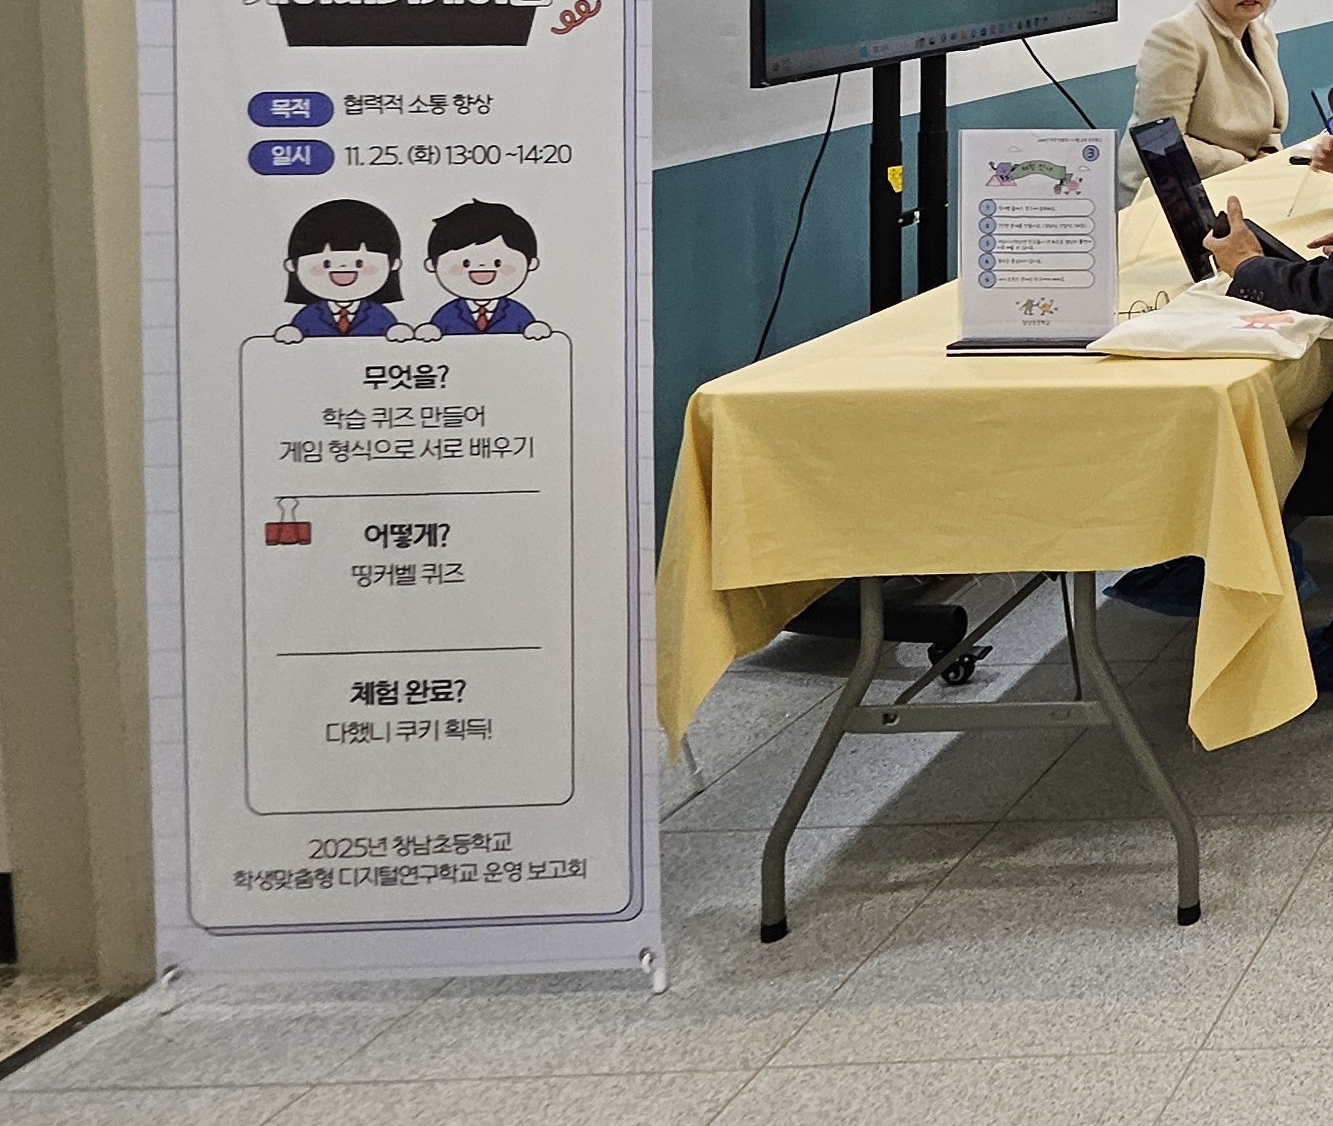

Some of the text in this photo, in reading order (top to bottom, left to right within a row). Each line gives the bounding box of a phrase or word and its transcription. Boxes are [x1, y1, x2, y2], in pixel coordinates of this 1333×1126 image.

[270, 98, 311, 118] 목적
[343, 94, 494, 115] 협력적 소통 향상
[271, 145, 312, 166] 일시
[407, 144, 442, 166] (화)
[447, 145, 501, 165] 13:00
[362, 364, 450, 390] 무엇을?
[322, 405, 486, 430] 학습 퀴즈 만들어
[278, 436, 534, 463] 게임 형식으로 서로 배우기
[364, 522, 450, 548] 어떻게?
[351, 562, 465, 588] 띵커벨 퀴즈
[350, 679, 467, 706] 체험 완료?
[326, 718, 492, 745] 다했니 쿠키 획득!
[308, 837, 388, 860] 2025년
[233, 857, 587, 891] 학생맞춤형 디지털연구학교 운영 보고회
